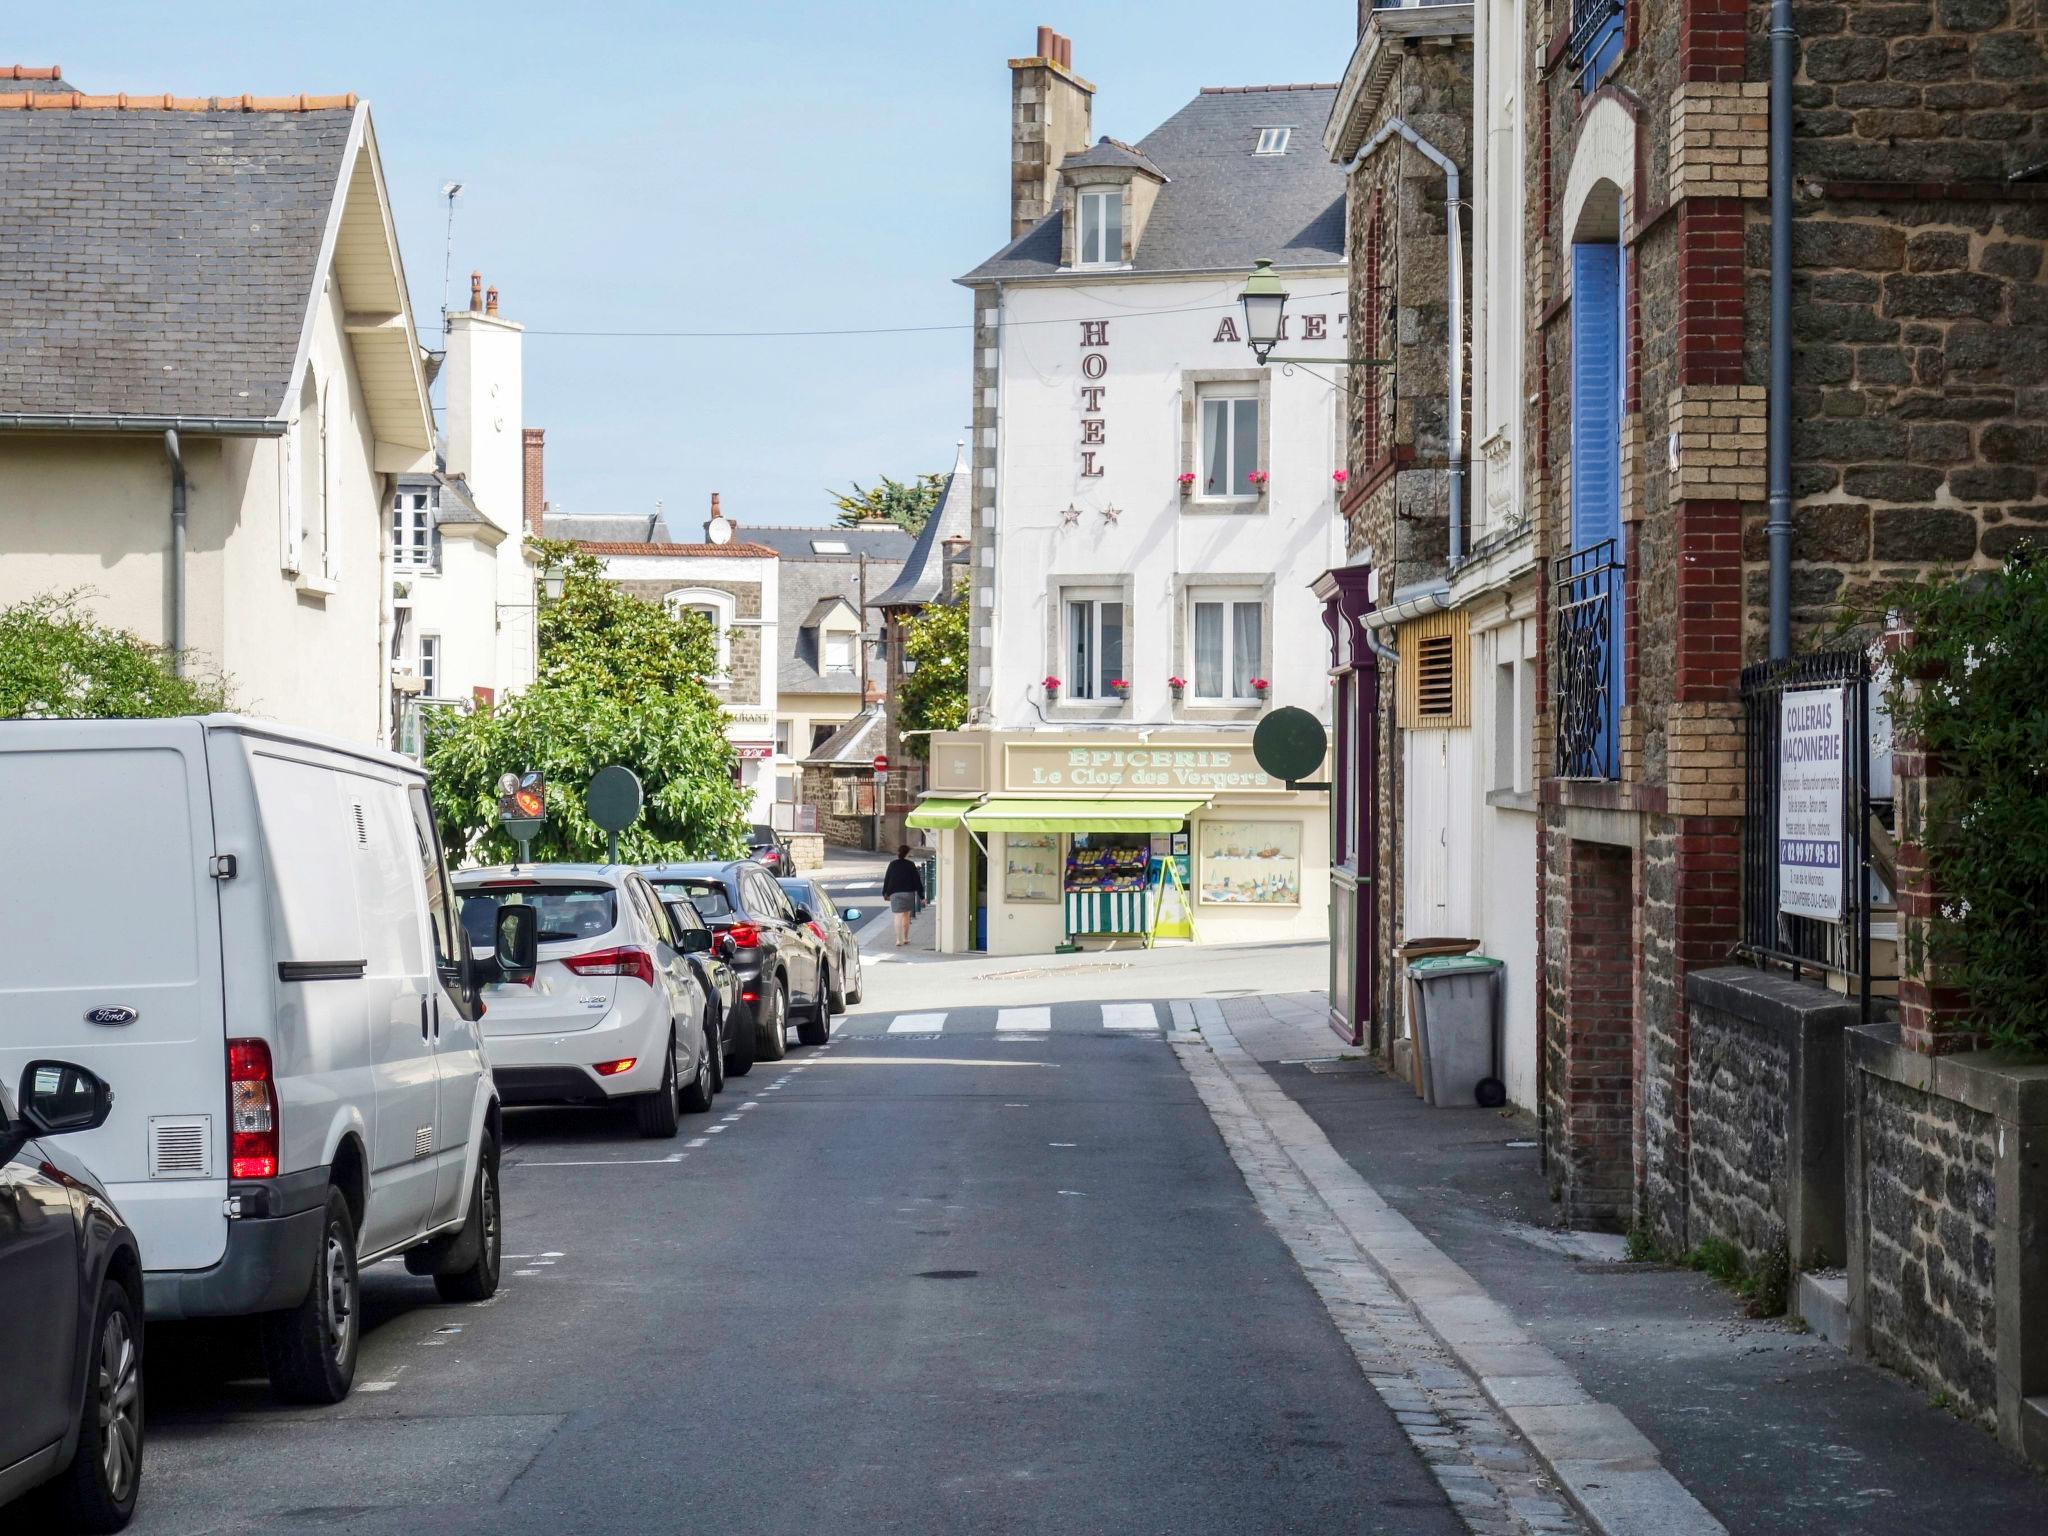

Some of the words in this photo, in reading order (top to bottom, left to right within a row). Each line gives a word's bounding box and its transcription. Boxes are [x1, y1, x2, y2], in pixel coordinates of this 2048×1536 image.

[1080, 320, 1109, 478] HOTEL
[1787, 702, 1832, 733] COLLERAIS
[1782, 734, 1840, 769] MAÇONNERIE
[1032, 767, 1062, 785] Le
[1071, 767, 1123, 785] Clos
[1131, 768, 1169, 785] des
[1173, 768, 1268, 790] Vergers
[1787, 842, 1795, 861] 02
[1796, 842, 1804, 862] 99
[1805, 843, 1814, 862] 97
[1815, 843, 1825, 864] 95
[1827, 844, 1838, 864] 81
[95, 1009, 126, 1021] Ford
